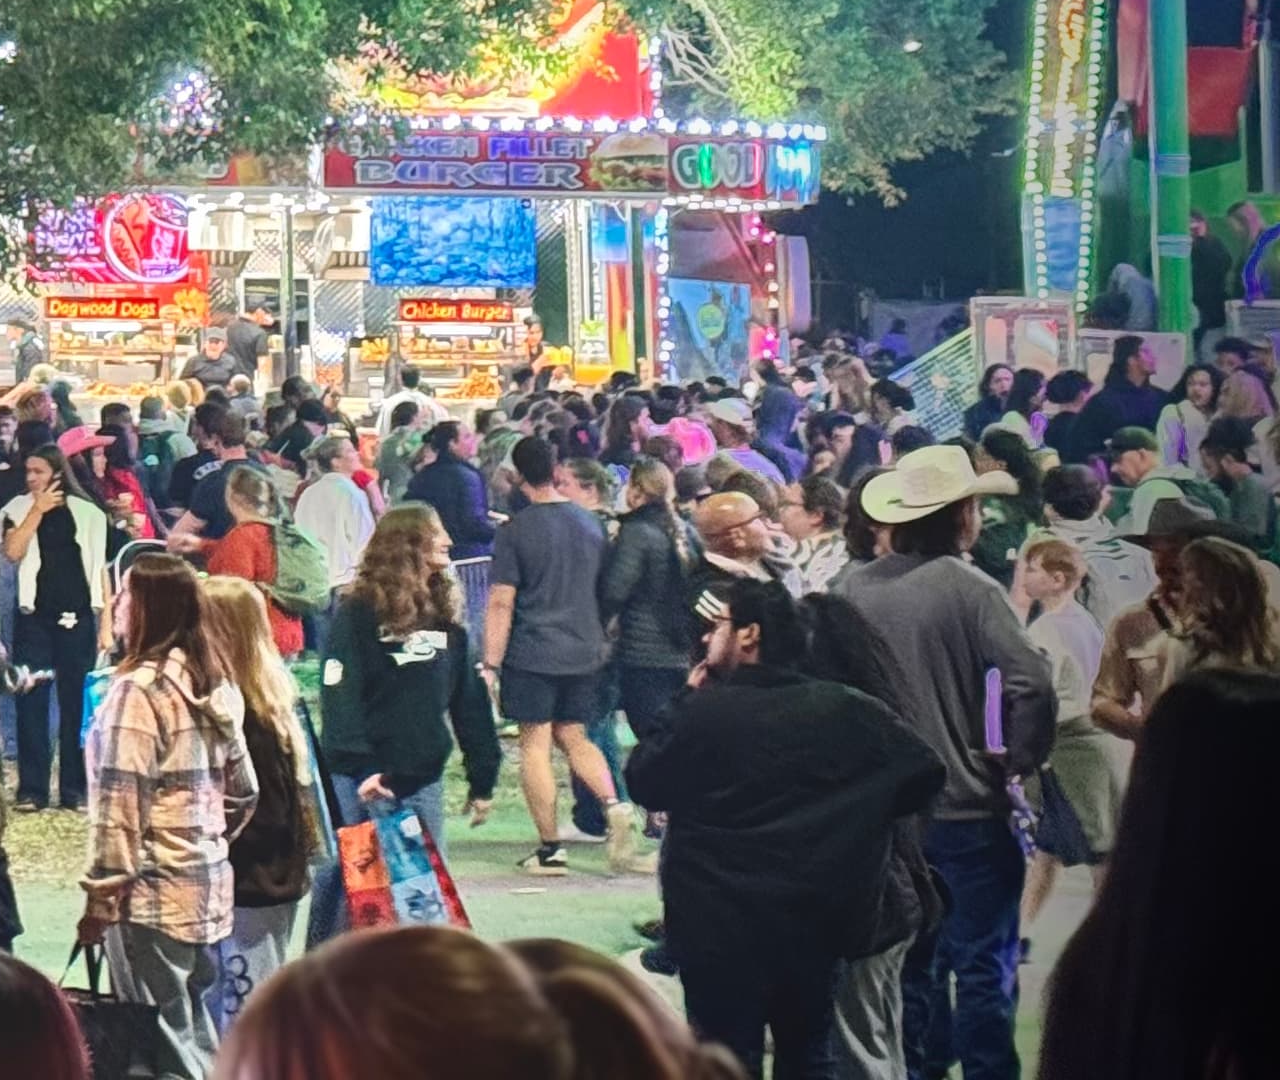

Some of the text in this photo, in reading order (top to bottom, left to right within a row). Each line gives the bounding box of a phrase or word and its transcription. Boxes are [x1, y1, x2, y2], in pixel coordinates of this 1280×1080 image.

[354, 159, 585, 189] BURGER
[49, 299, 157, 316] Dagwood Dogs
[402, 301, 510, 321] Chicken Burger
